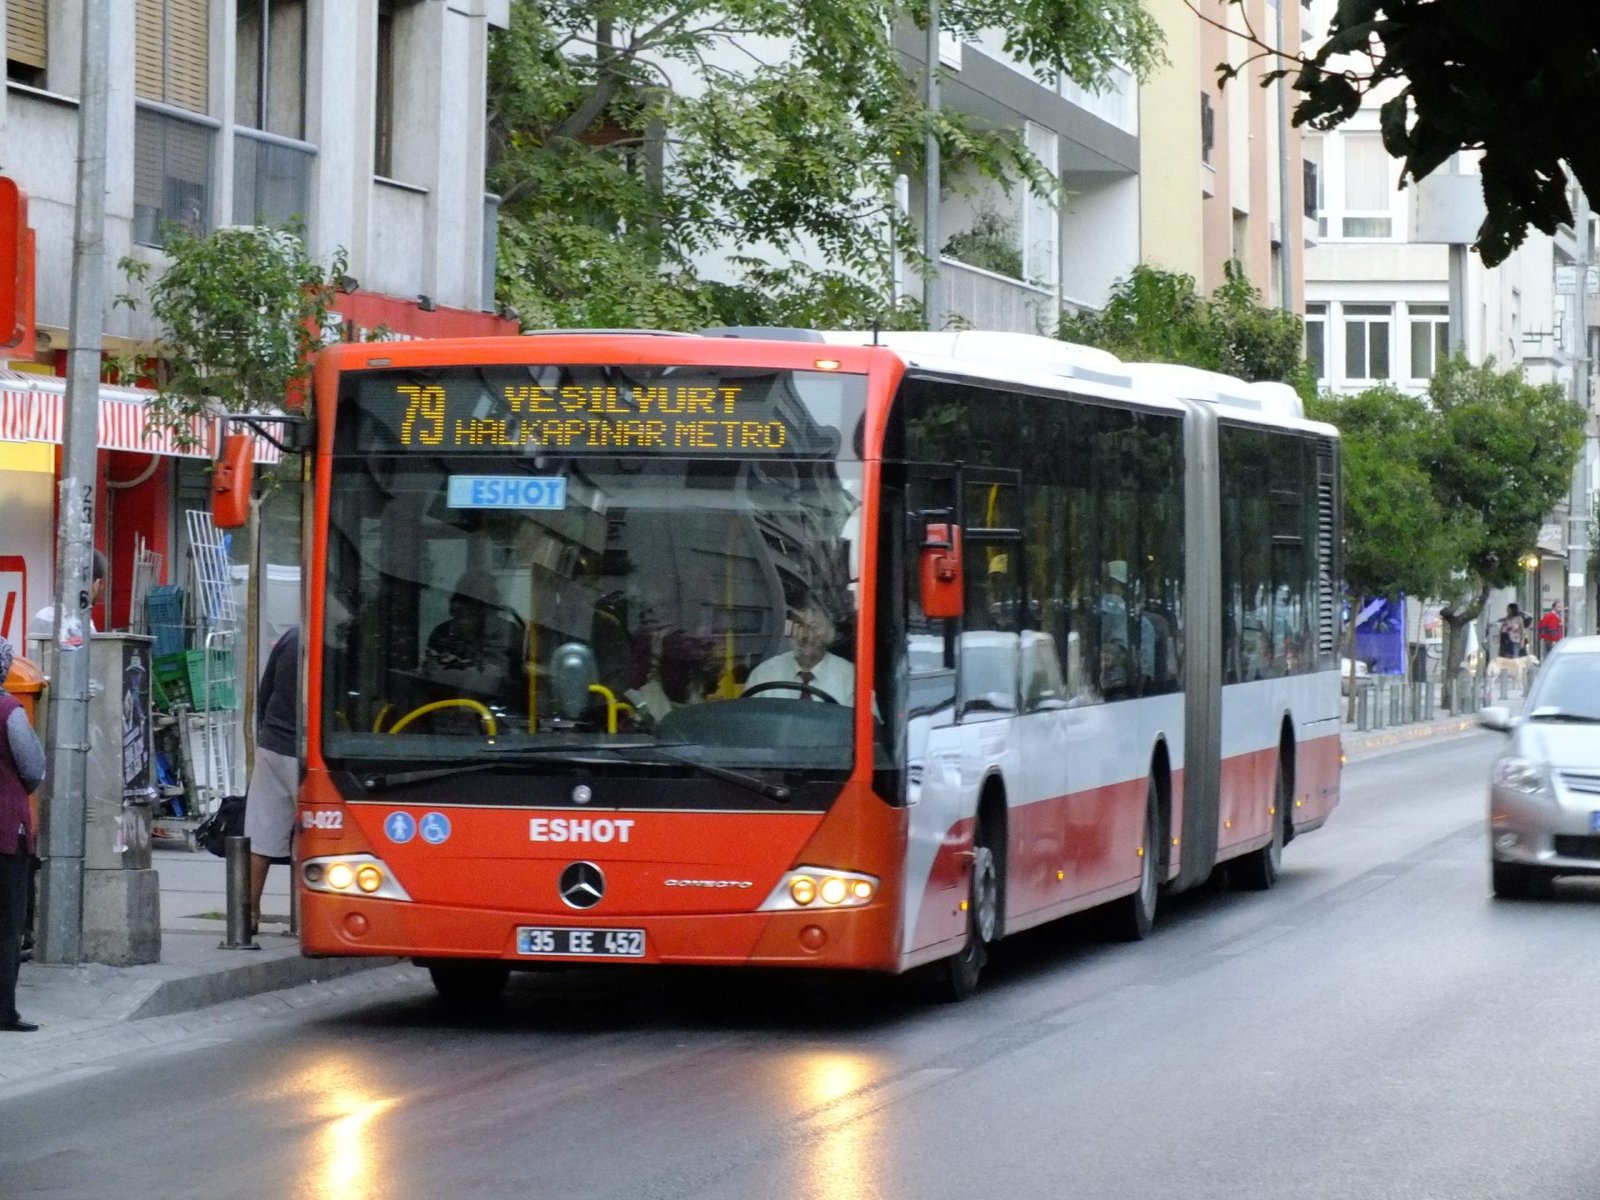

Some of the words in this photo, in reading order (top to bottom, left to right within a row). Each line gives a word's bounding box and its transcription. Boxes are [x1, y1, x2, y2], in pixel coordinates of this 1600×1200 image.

[505, 385, 742, 414] YESILYURT
[396, 385, 446, 446] 79
[455, 419, 667, 447] HALKAPINAR
[674, 420, 787, 449] METRO
[472, 479, 561, 506] ESHOT
[529, 817, 635, 843] ESHOT
[530, 930, 555, 952] 35
[569, 931, 594, 953] EE
[604, 932, 641, 954] 452
